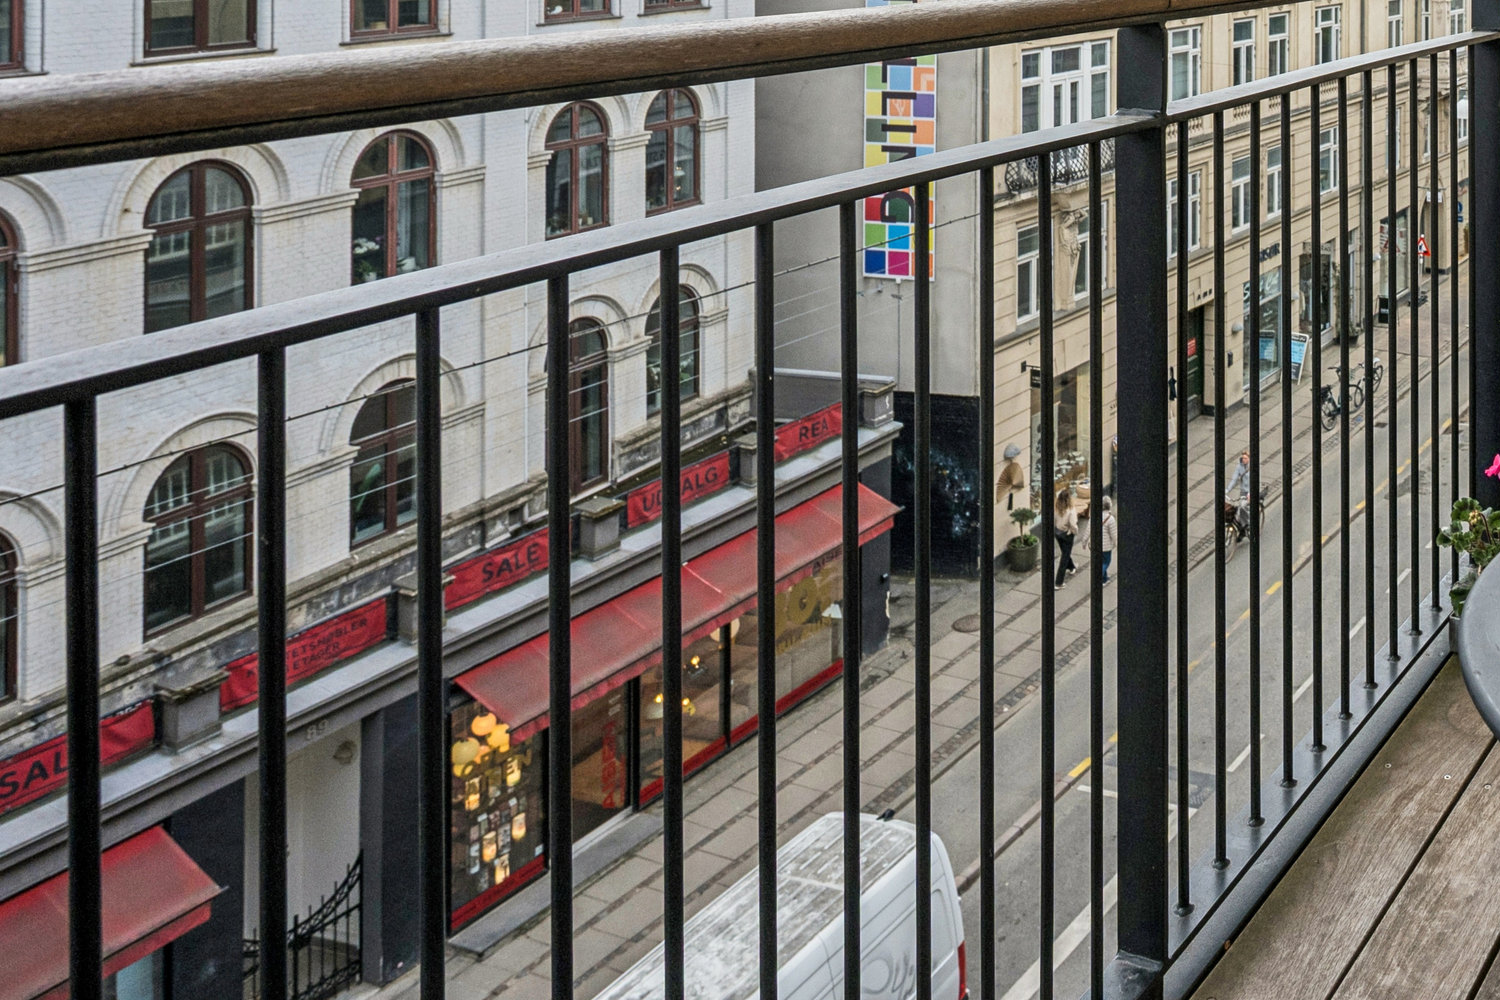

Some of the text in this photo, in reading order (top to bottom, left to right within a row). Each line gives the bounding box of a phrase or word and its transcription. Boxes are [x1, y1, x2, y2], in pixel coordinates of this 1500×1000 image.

[799, 417, 829, 442] REA
[642, 466, 719, 512] UDALG
[481, 542, 540, 583] SALE
[0, 751, 69, 798] SAL
